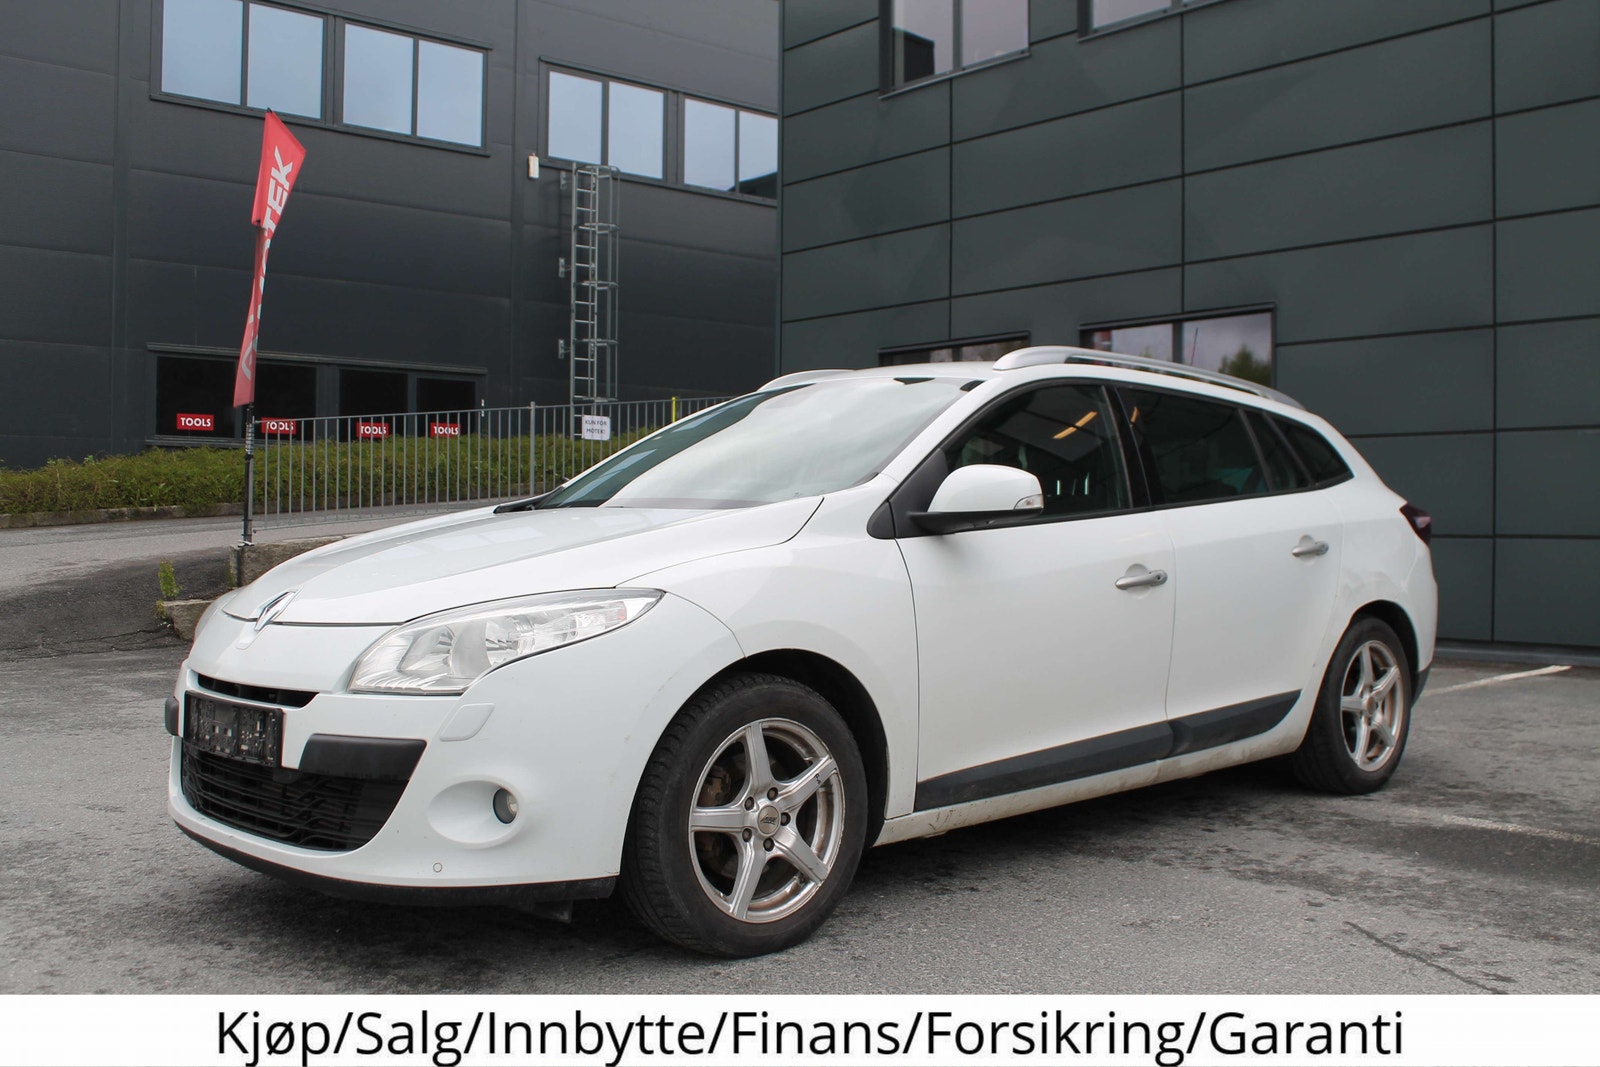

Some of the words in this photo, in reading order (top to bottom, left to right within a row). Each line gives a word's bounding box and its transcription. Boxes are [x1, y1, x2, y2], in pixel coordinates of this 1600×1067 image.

[181, 417, 211, 427] TOOLS
[360, 425, 387, 434] TOOLS
[434, 425, 459, 435] TOOLS
